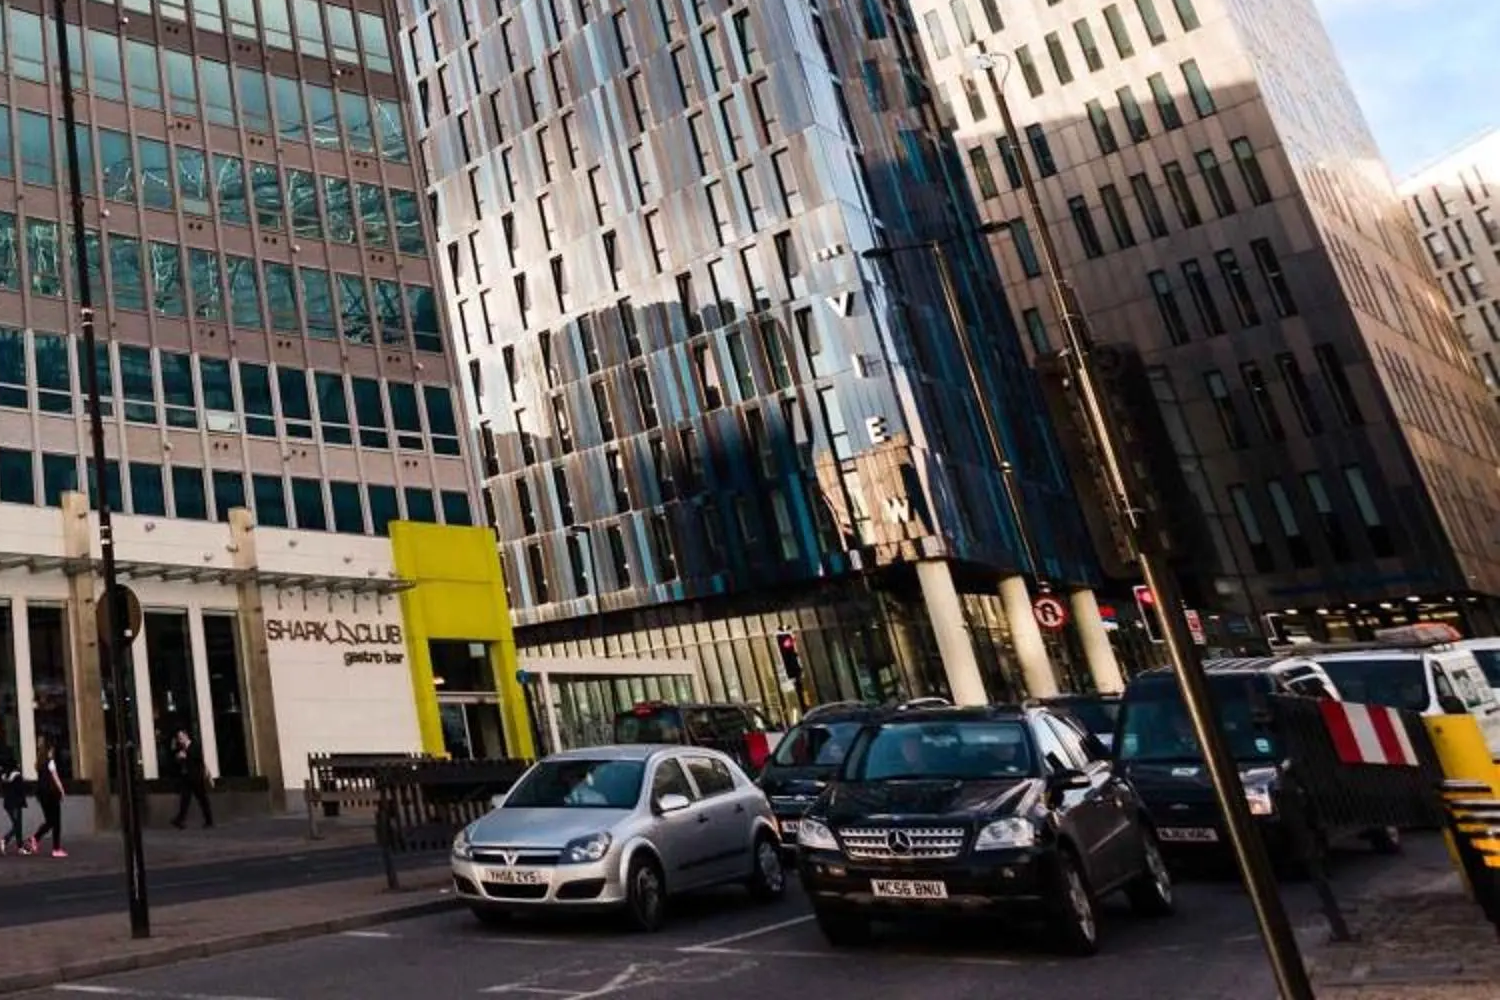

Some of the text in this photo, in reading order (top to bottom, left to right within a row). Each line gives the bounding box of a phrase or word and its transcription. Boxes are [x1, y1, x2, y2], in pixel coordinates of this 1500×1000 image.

[266, 619, 403, 644] SHARK CLUB
[383, 650, 404, 664] bar
